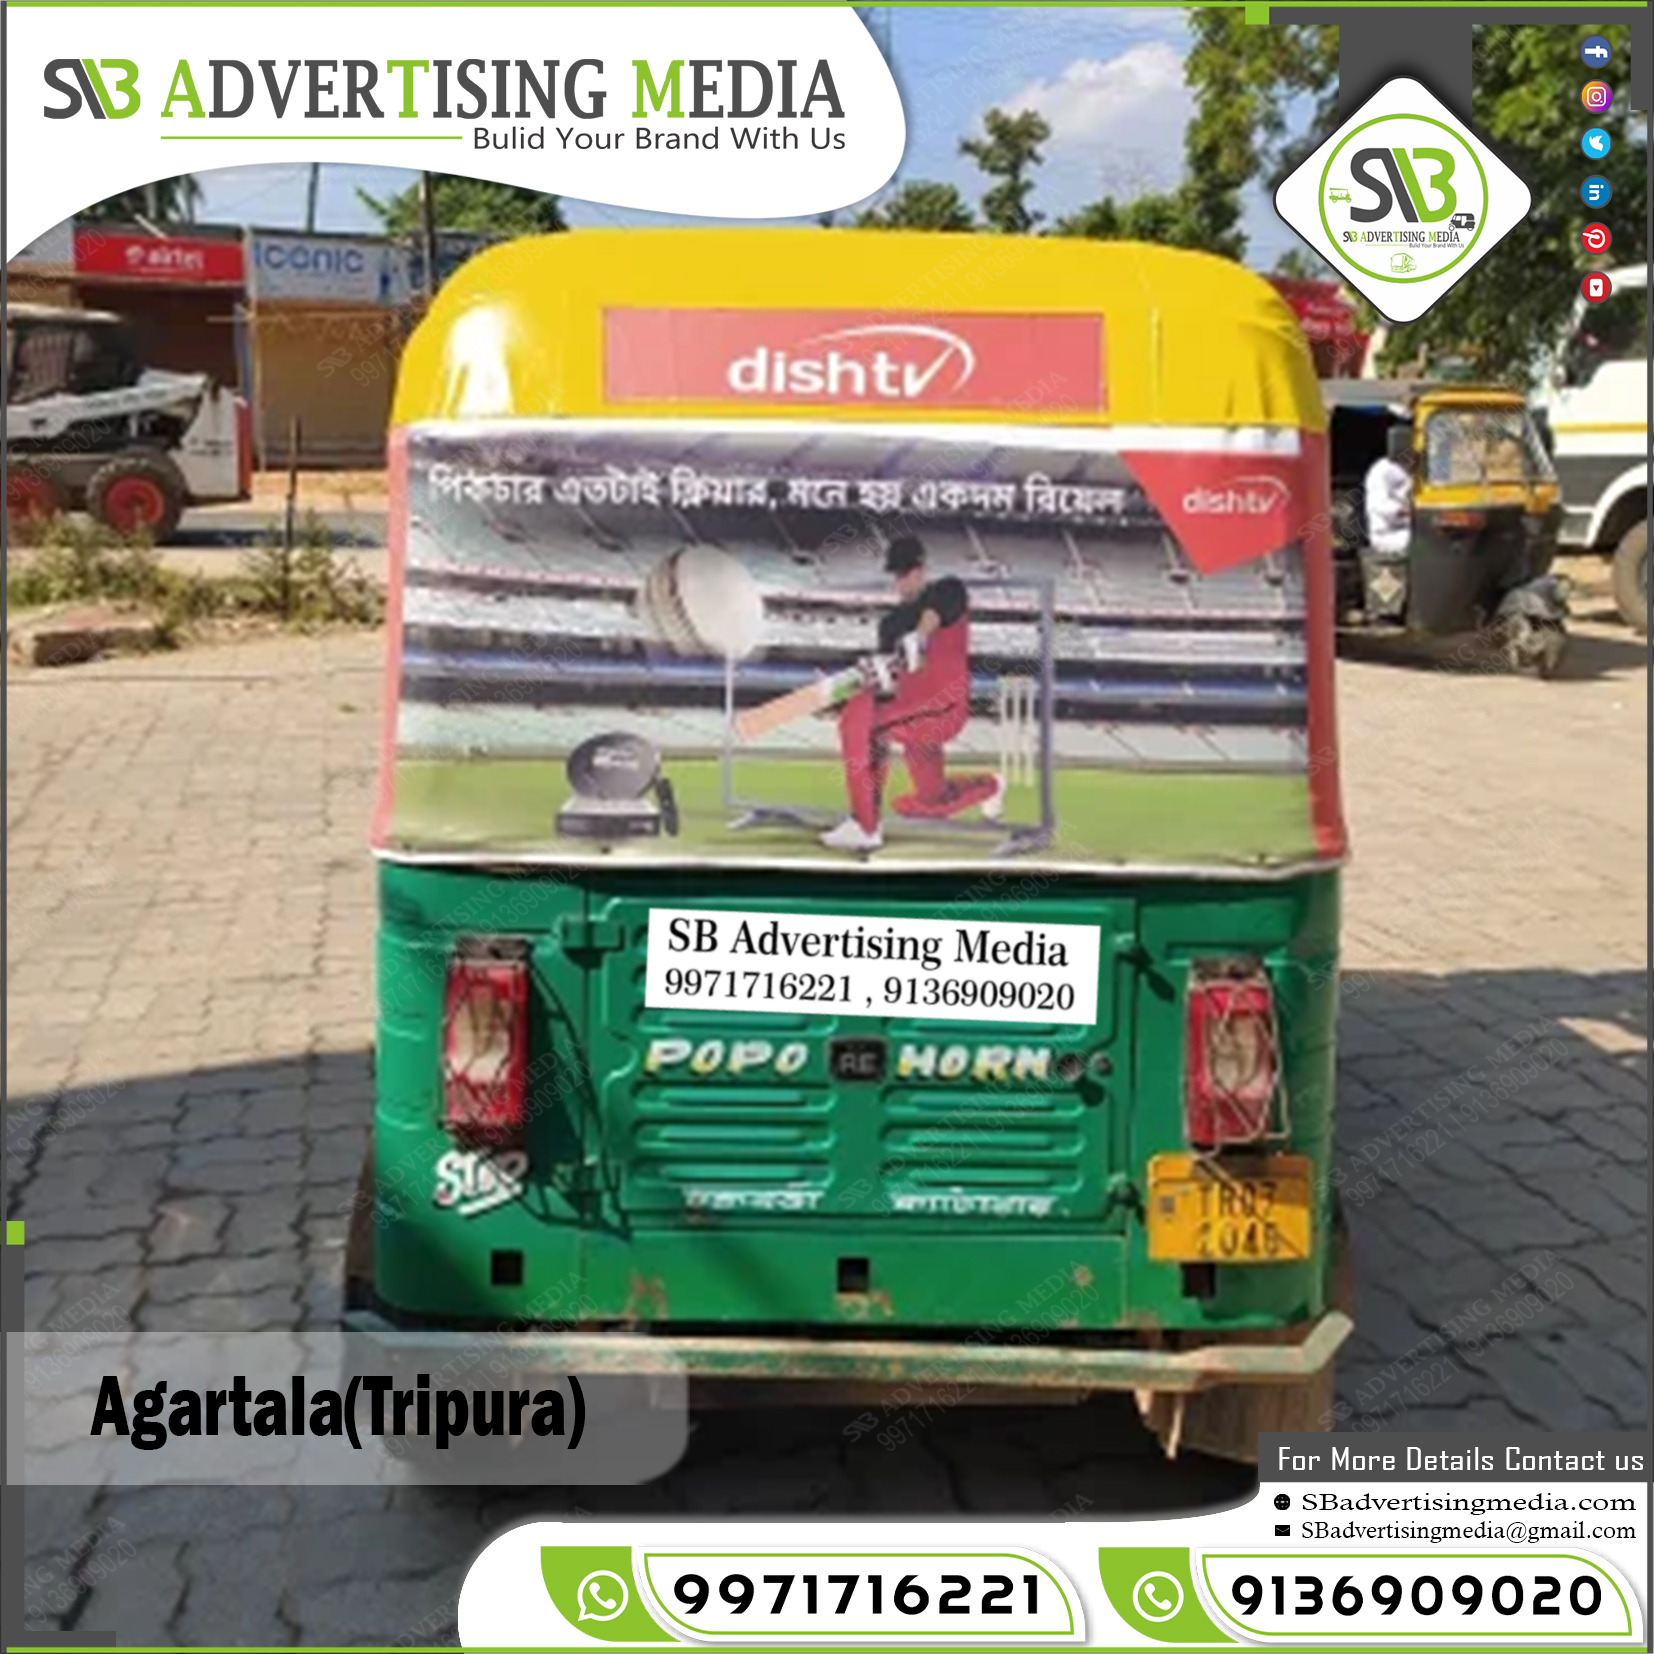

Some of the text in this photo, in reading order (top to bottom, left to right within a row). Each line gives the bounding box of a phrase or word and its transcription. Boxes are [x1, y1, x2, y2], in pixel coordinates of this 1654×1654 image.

[727, 345, 957, 398] dishtv
[1182, 487, 1279, 514] dishtv
[644, 1038, 808, 1075] POPO
